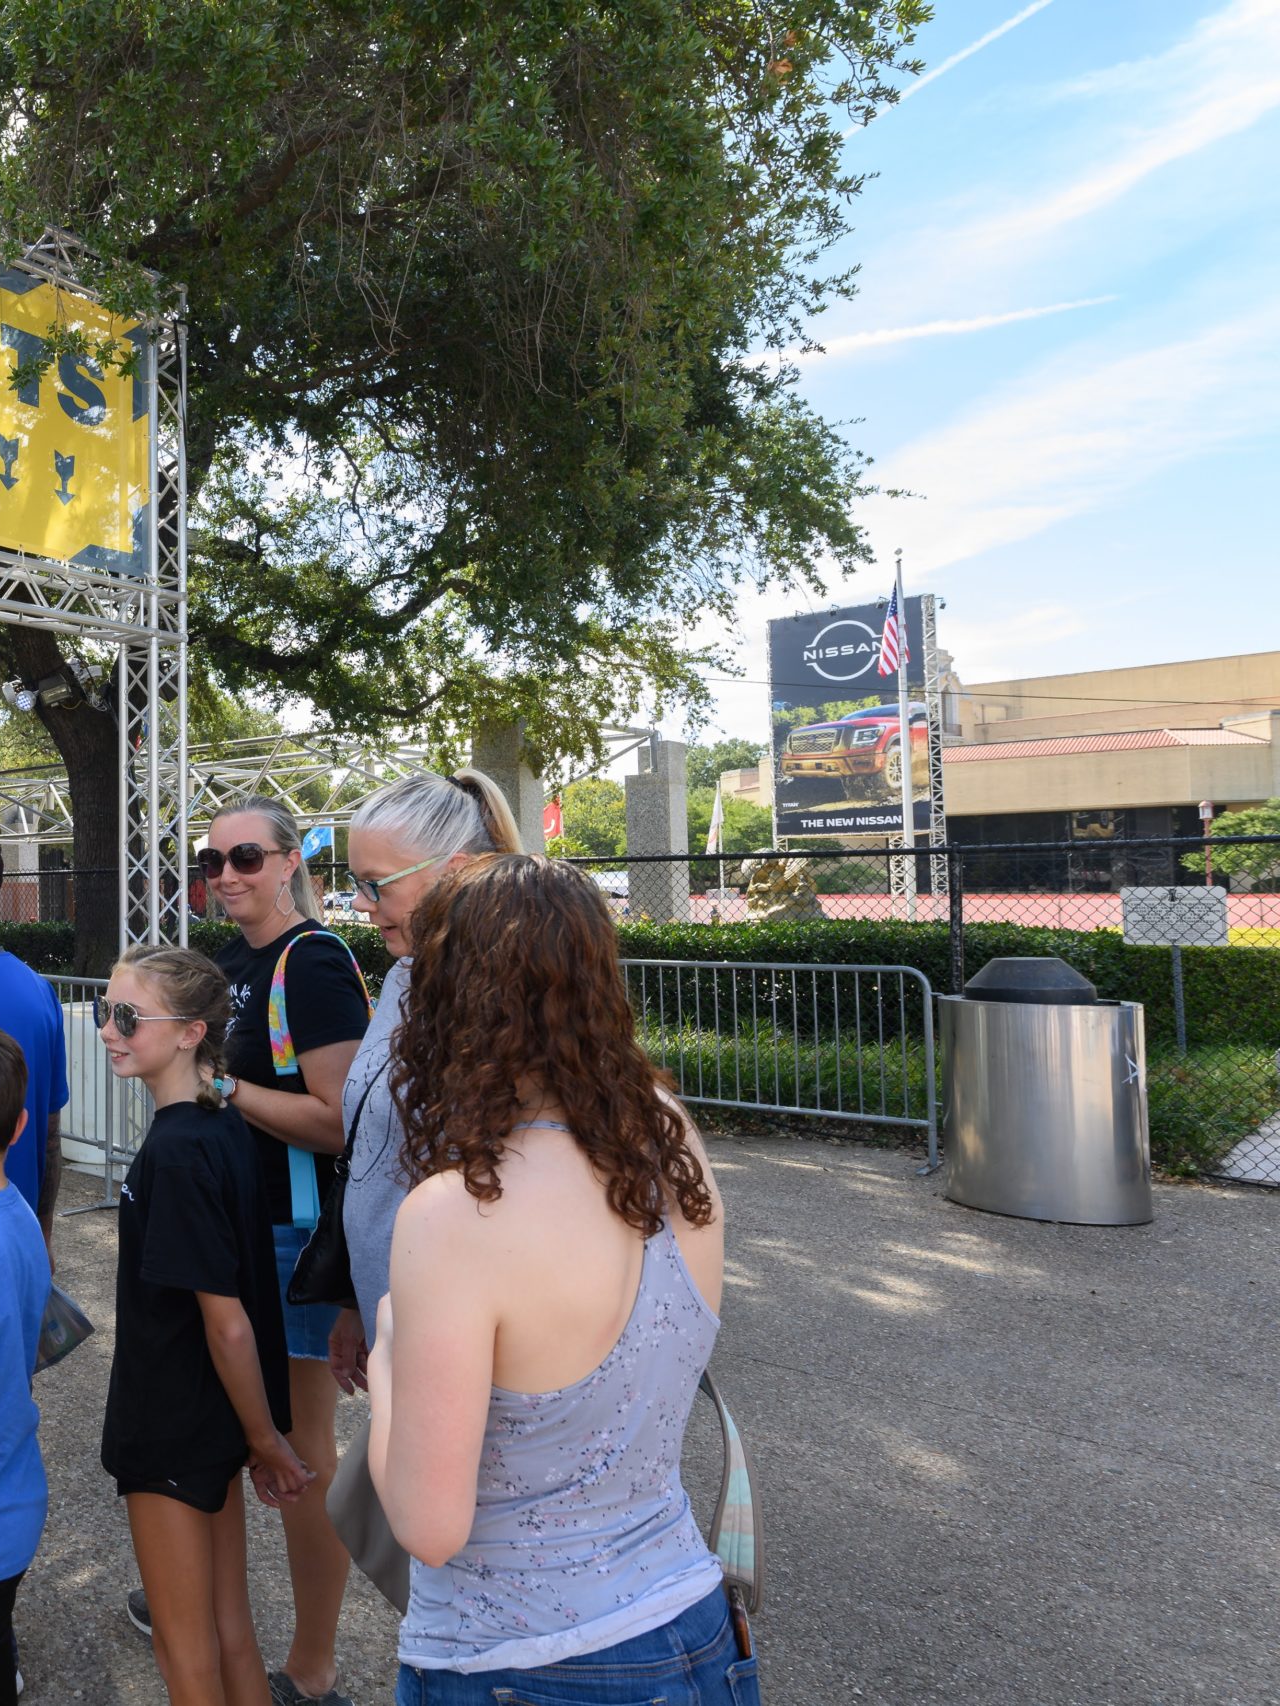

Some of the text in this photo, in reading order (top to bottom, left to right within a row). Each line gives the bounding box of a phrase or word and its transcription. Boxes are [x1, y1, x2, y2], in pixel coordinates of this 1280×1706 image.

[804, 641, 883, 660] NISSAN
[801, 815, 902, 828] THE NEW NISSAN
